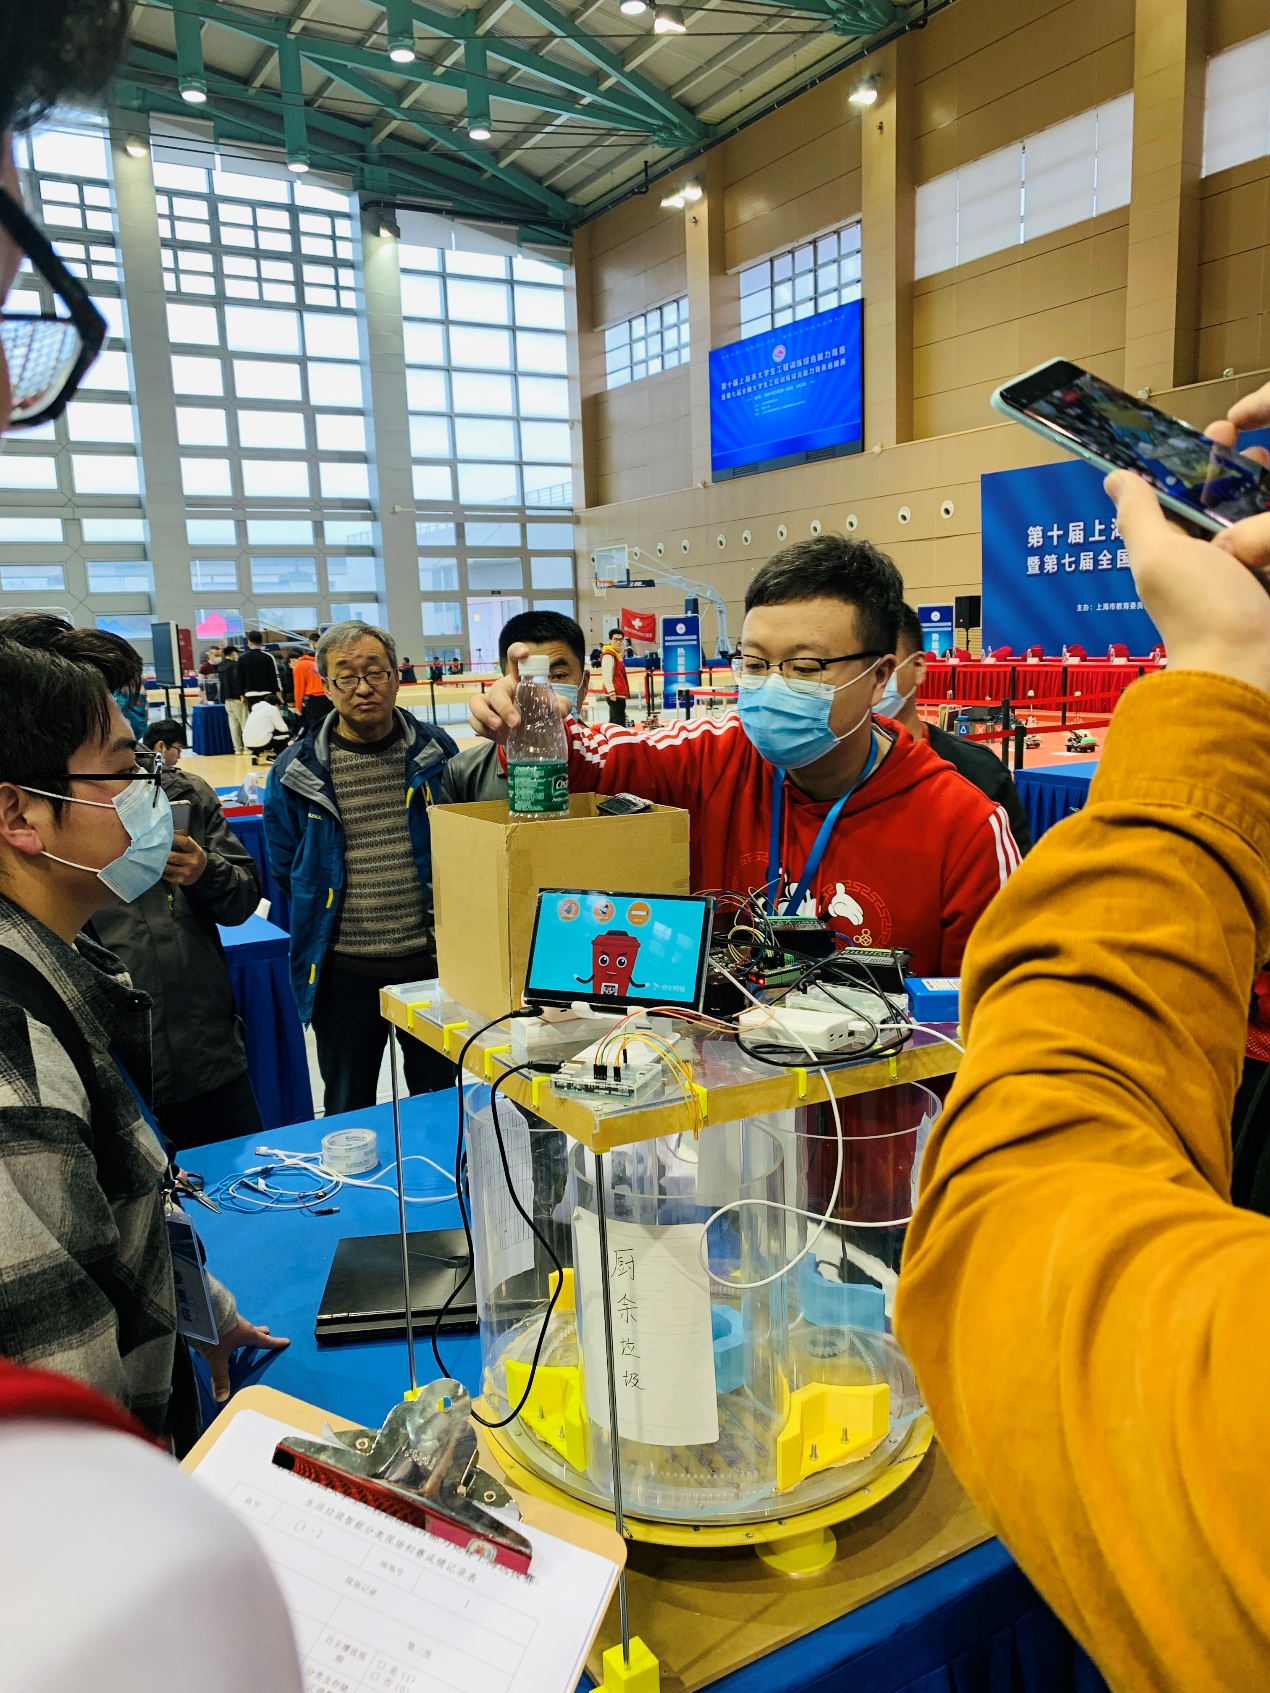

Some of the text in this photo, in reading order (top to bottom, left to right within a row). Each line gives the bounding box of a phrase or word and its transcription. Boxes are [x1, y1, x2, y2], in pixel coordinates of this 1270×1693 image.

[1026, 549, 1132, 575] 暨第七届全国
[611, 1248, 646, 1391] 厨余垃圾
[304, 1497, 477, 1584] 生活垃圾智能分类现场初赛成绩记录表
[380, 1559, 405, 1577] 场地号
[344, 1575, 378, 1597] 现场记录
[406, 1641, 433, 1661] 第二次
